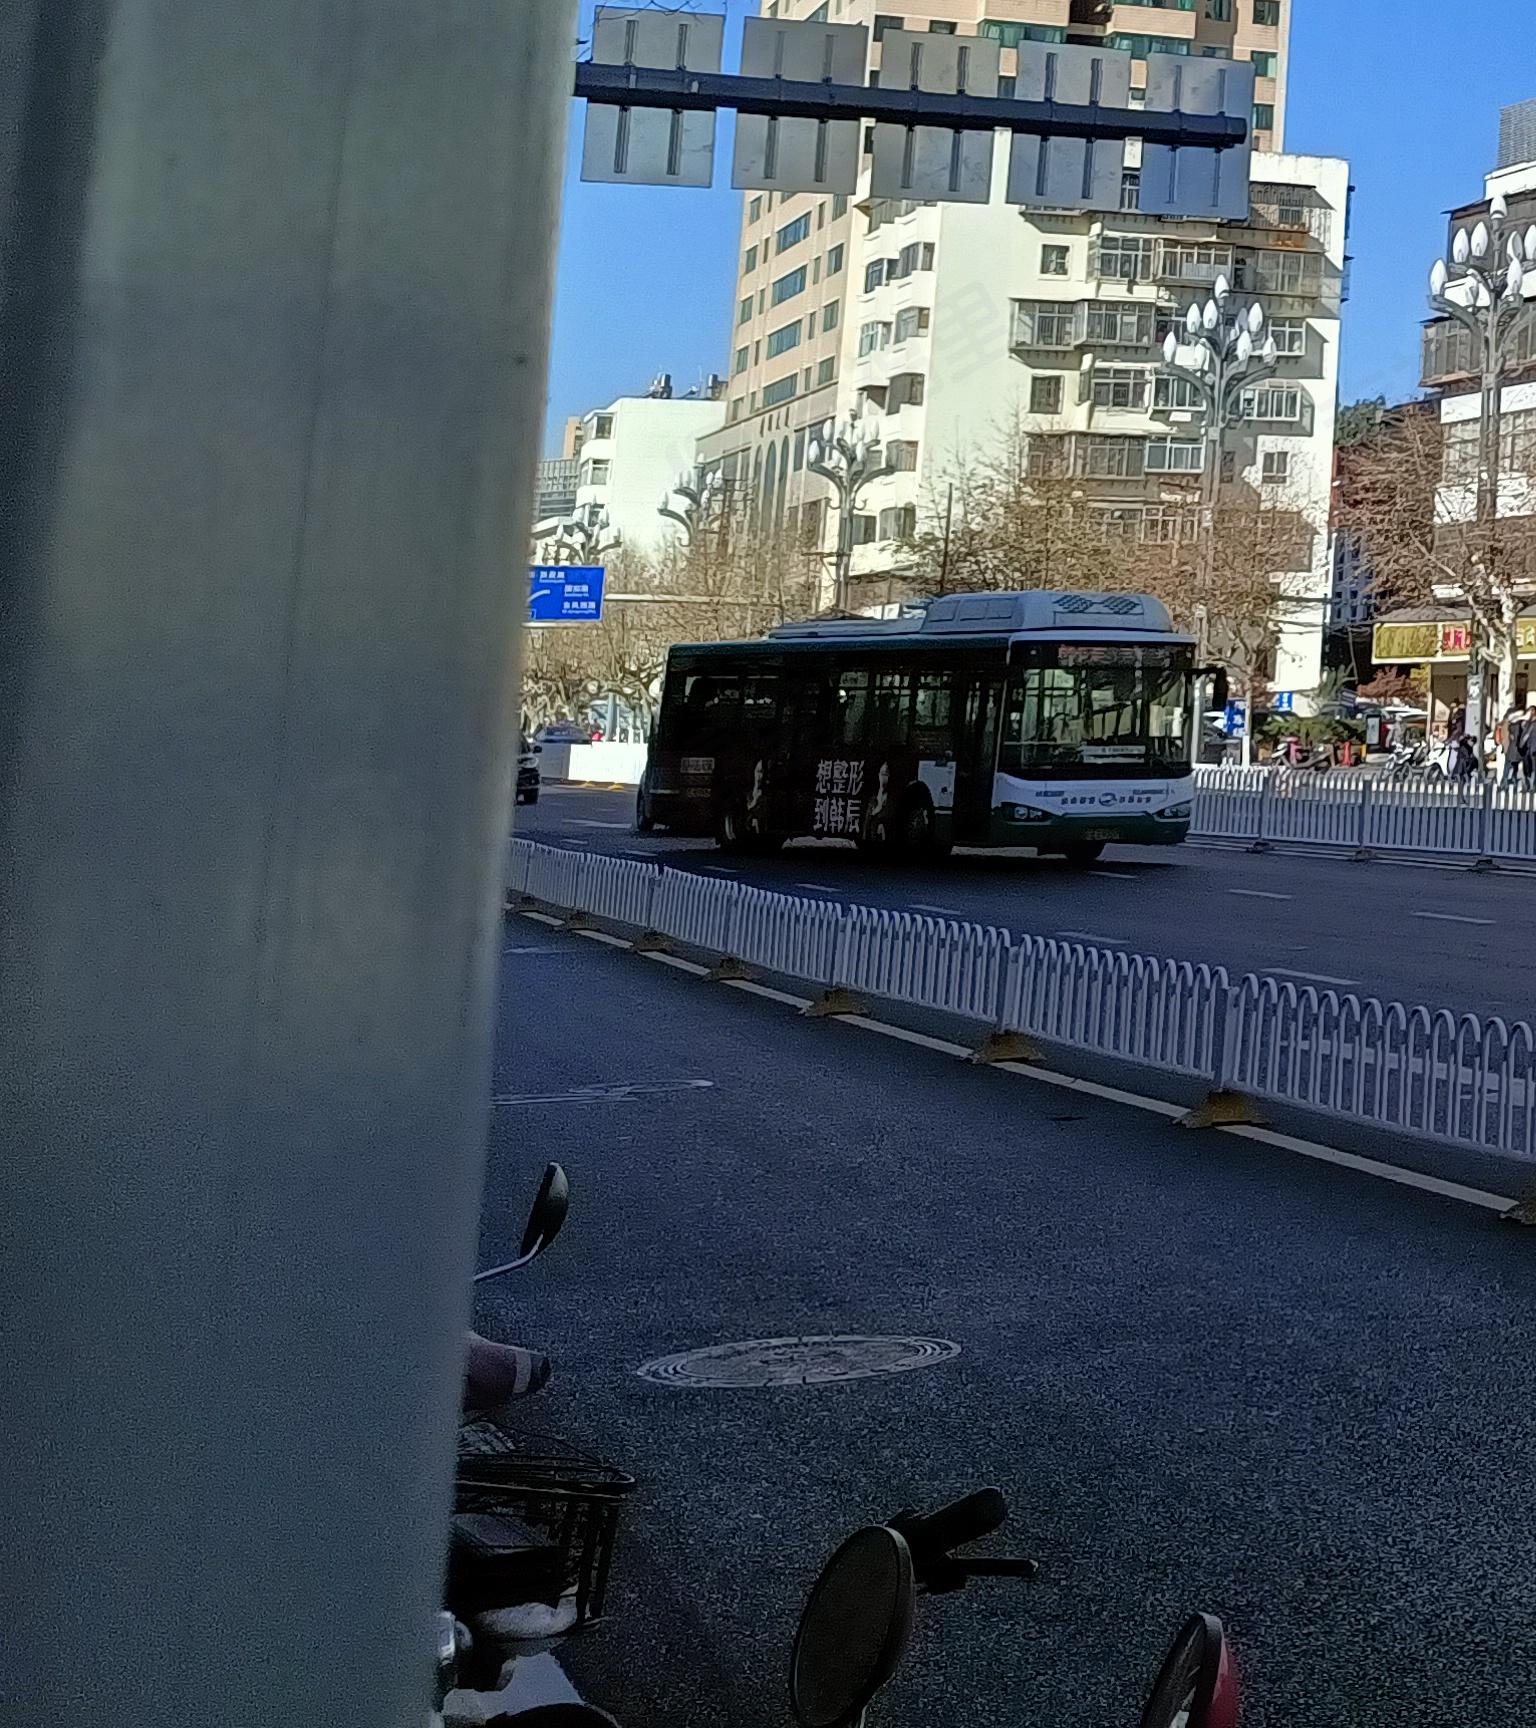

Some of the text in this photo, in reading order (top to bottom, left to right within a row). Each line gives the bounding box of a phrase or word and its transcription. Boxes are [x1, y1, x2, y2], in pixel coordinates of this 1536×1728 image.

[815, 759, 864, 795] 想整形
[813, 797, 863, 834] 到韩辰
